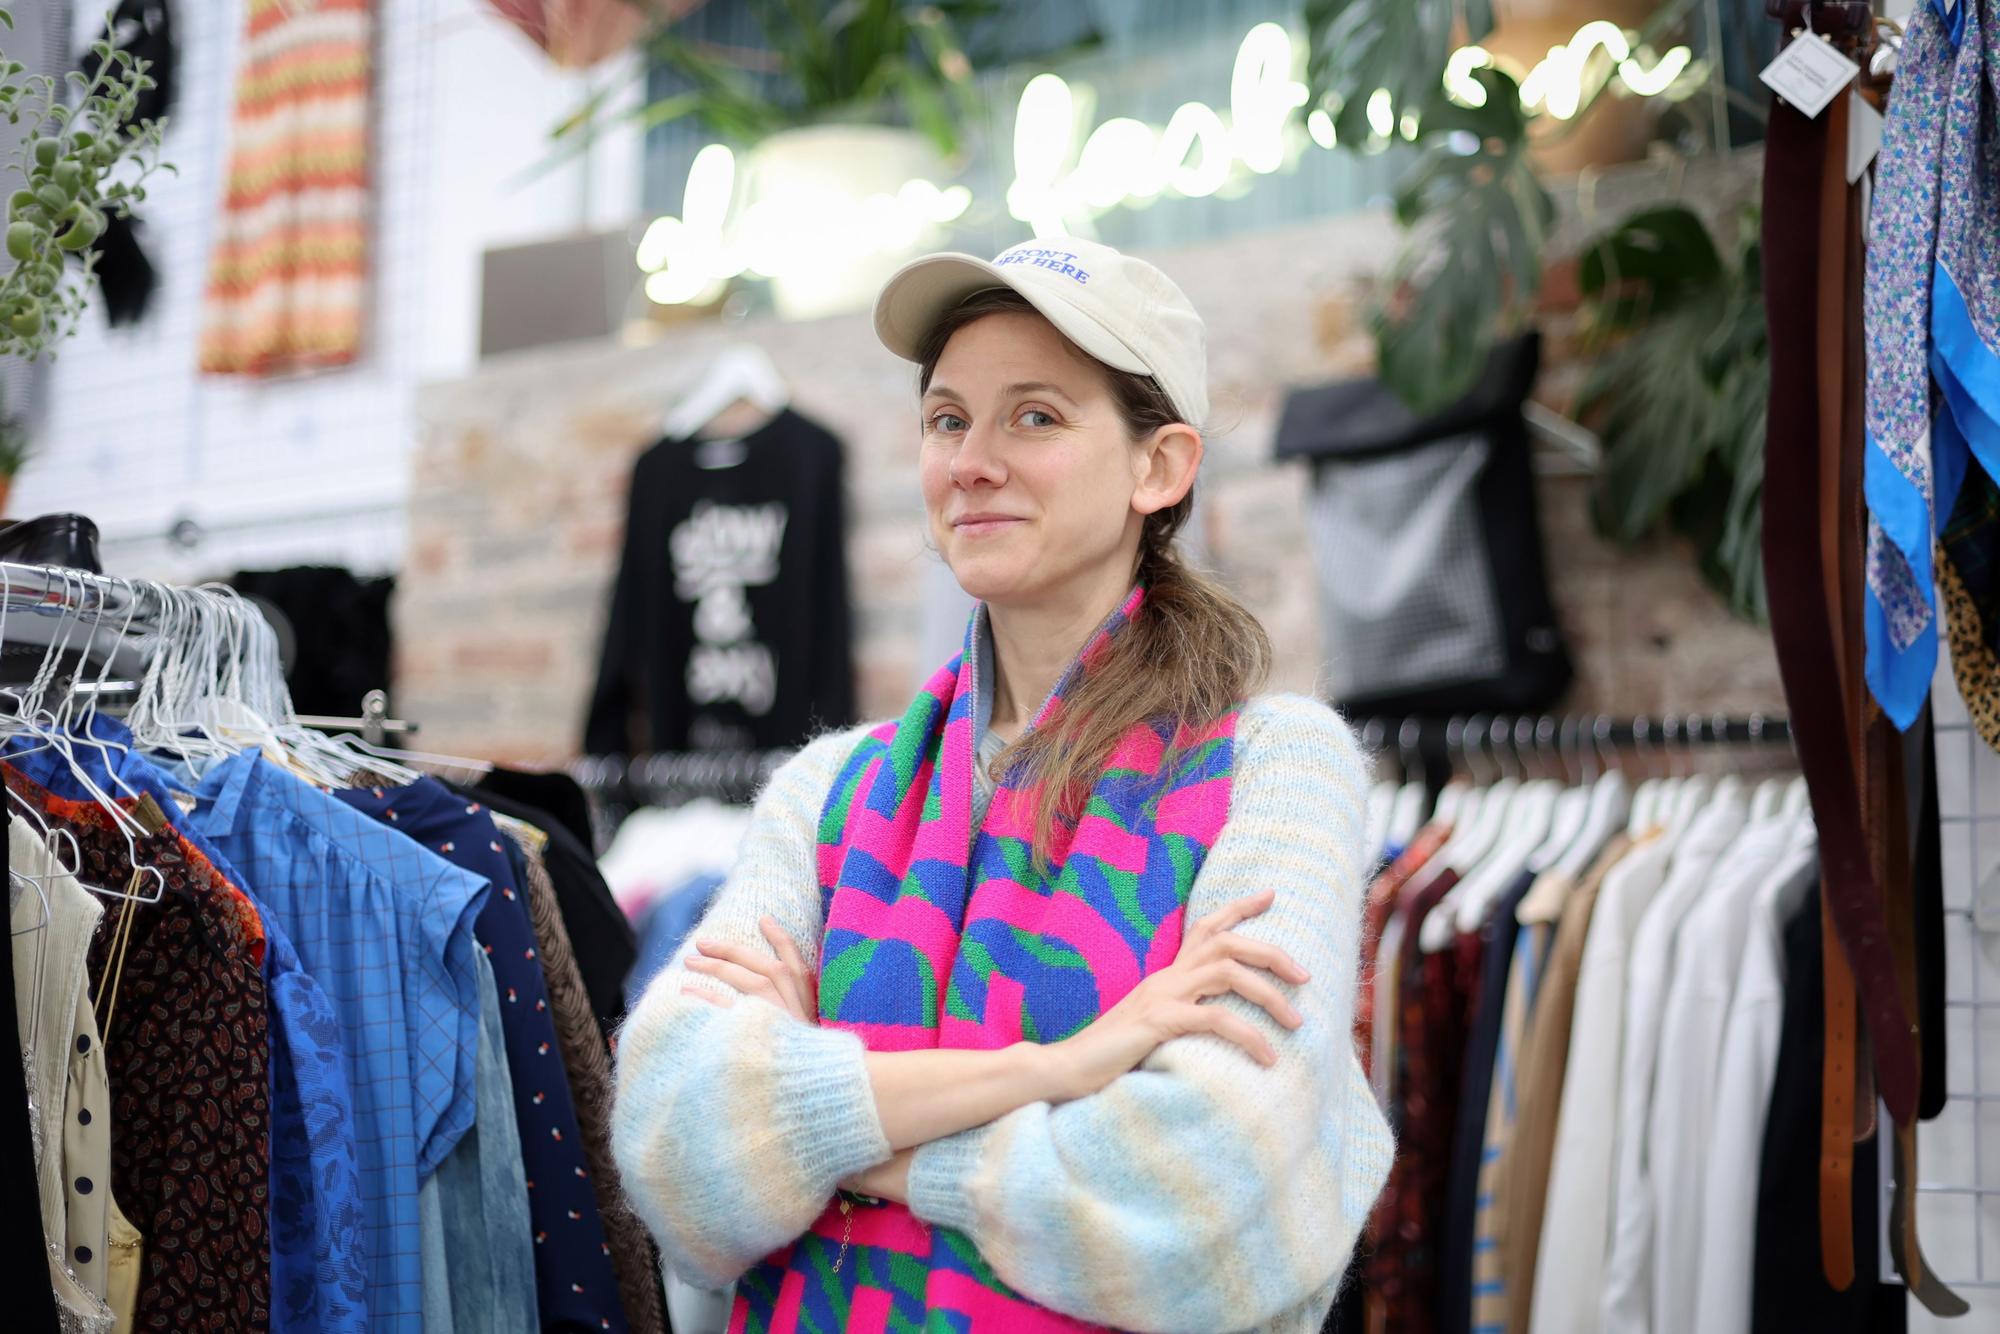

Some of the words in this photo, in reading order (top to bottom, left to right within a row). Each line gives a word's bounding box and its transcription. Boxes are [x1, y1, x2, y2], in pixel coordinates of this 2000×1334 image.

[1011, 249, 1078, 262] DON'T
[992, 253, 1030, 267] ARK
[1032, 257, 1090, 285] HERE
